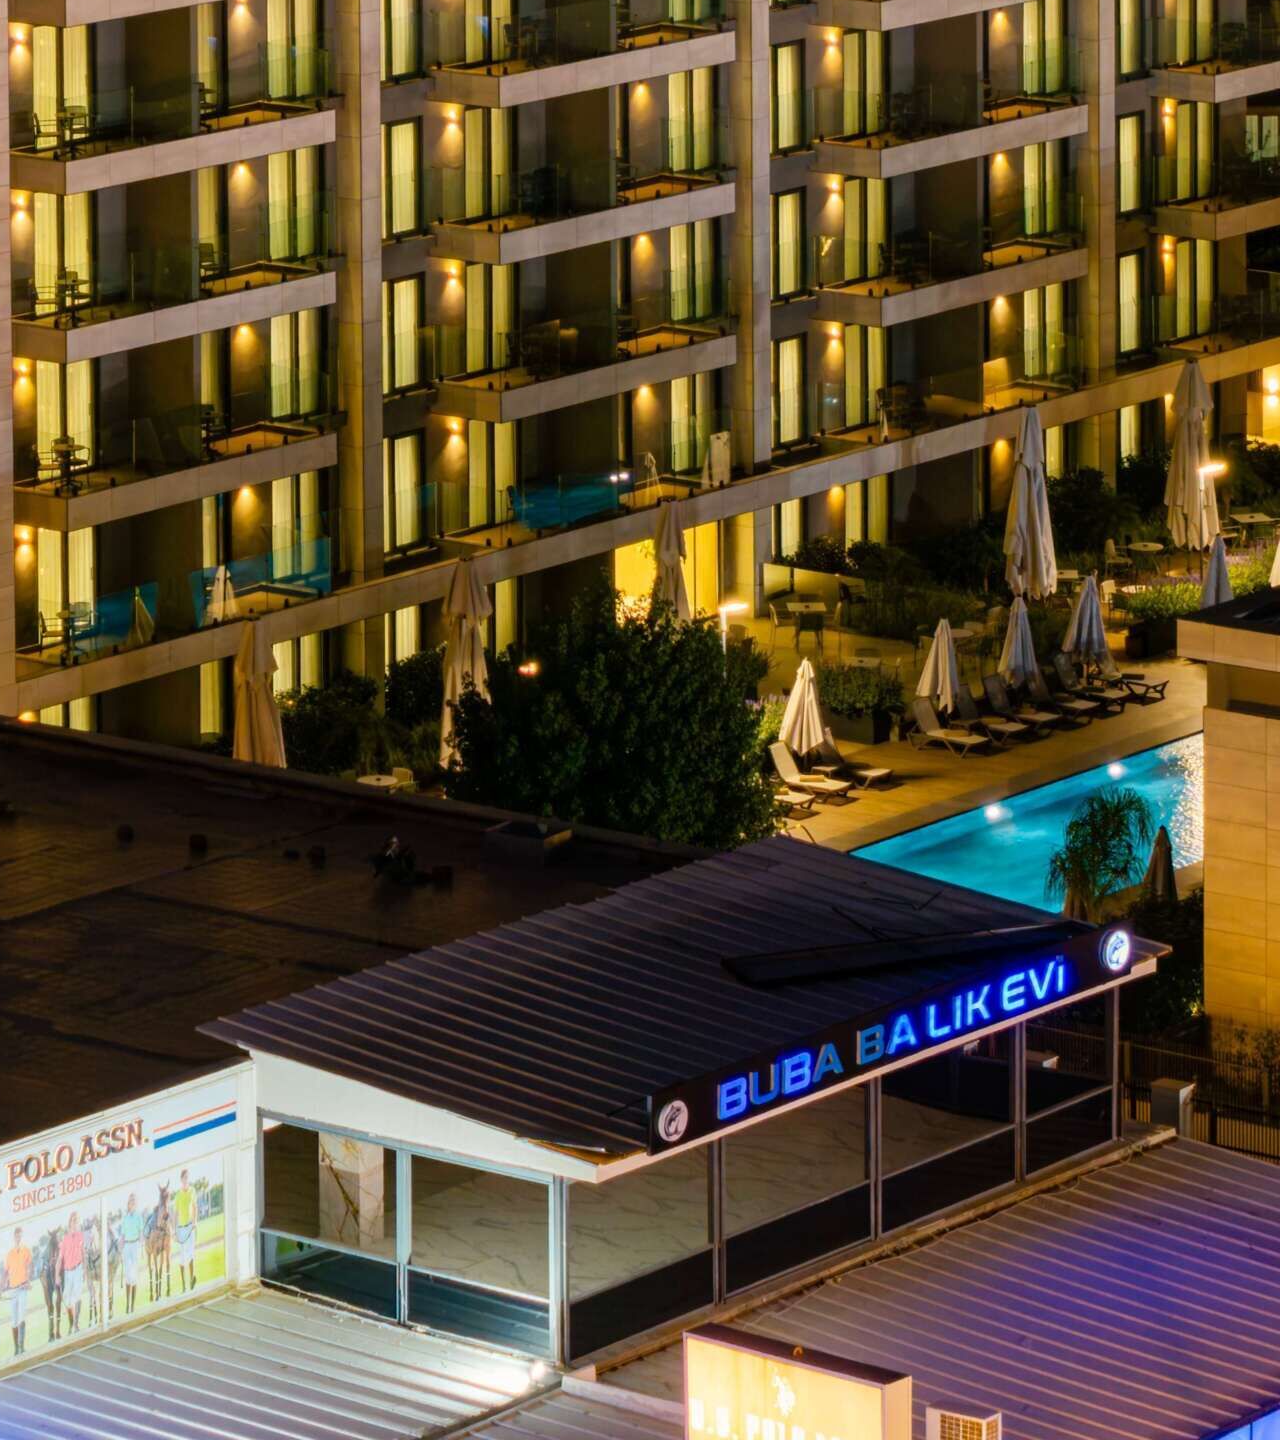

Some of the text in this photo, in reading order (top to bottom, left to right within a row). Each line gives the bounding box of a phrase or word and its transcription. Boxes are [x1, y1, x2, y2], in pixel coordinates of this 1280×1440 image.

[717, 1040, 844, 1121] BUBA
[1001, 955, 1065, 1012] EVİ
[5, 1143, 75, 1191] POLO
[77, 1116, 150, 1166] ASSN.
[12, 1170, 93, 1213] SINCE 1890
